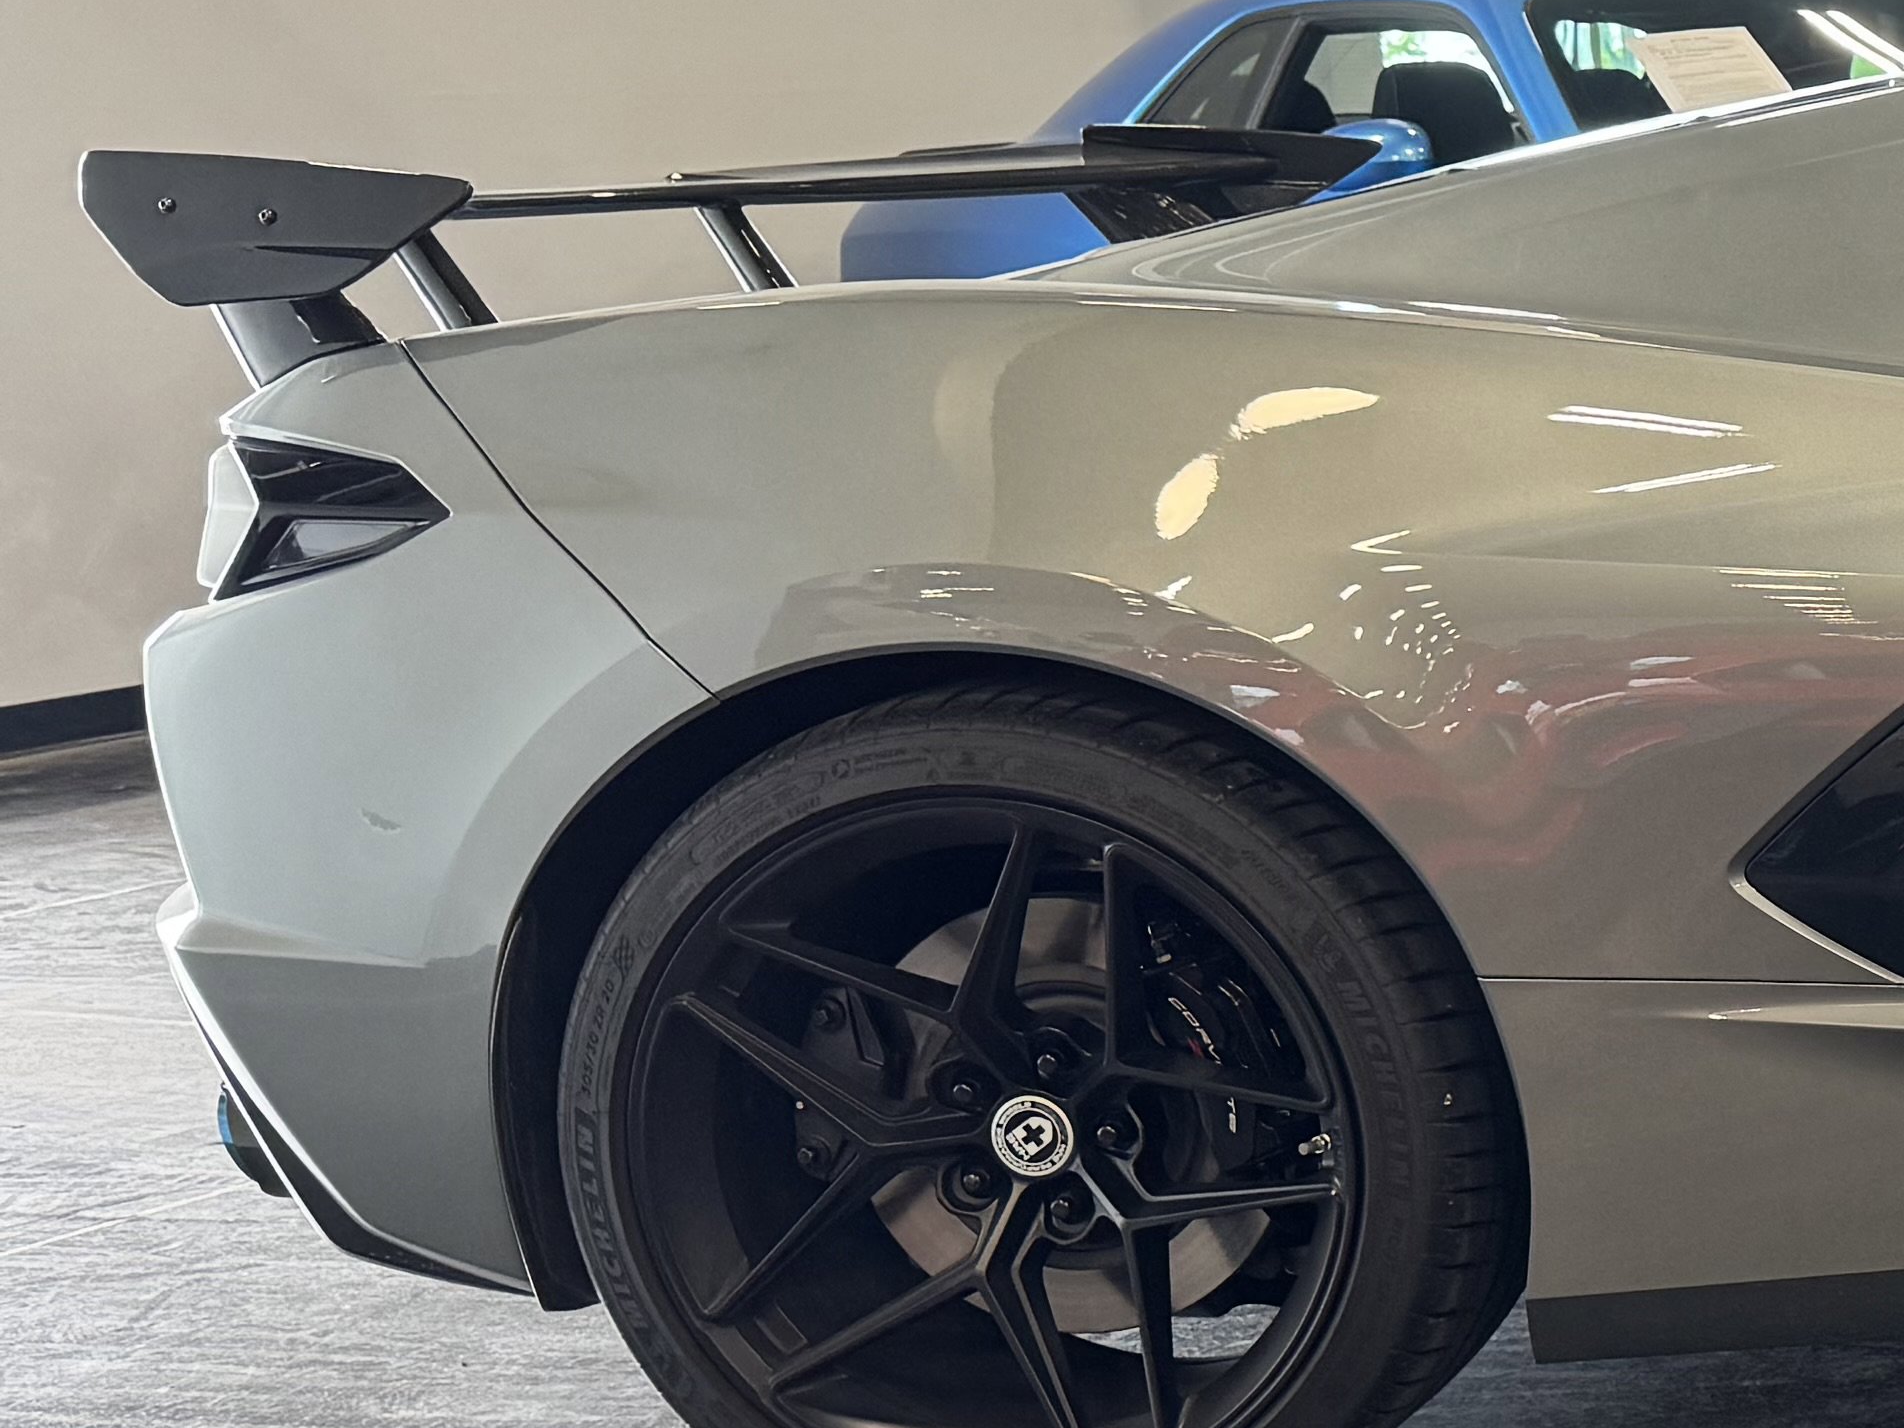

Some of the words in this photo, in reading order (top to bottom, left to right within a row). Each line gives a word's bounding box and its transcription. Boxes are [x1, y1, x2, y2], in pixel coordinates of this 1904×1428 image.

[600, 977, 616, 1005] 20
[1337, 980, 1415, 1198] MICHELIN
[574, 1121, 651, 1331] MICHELIN
